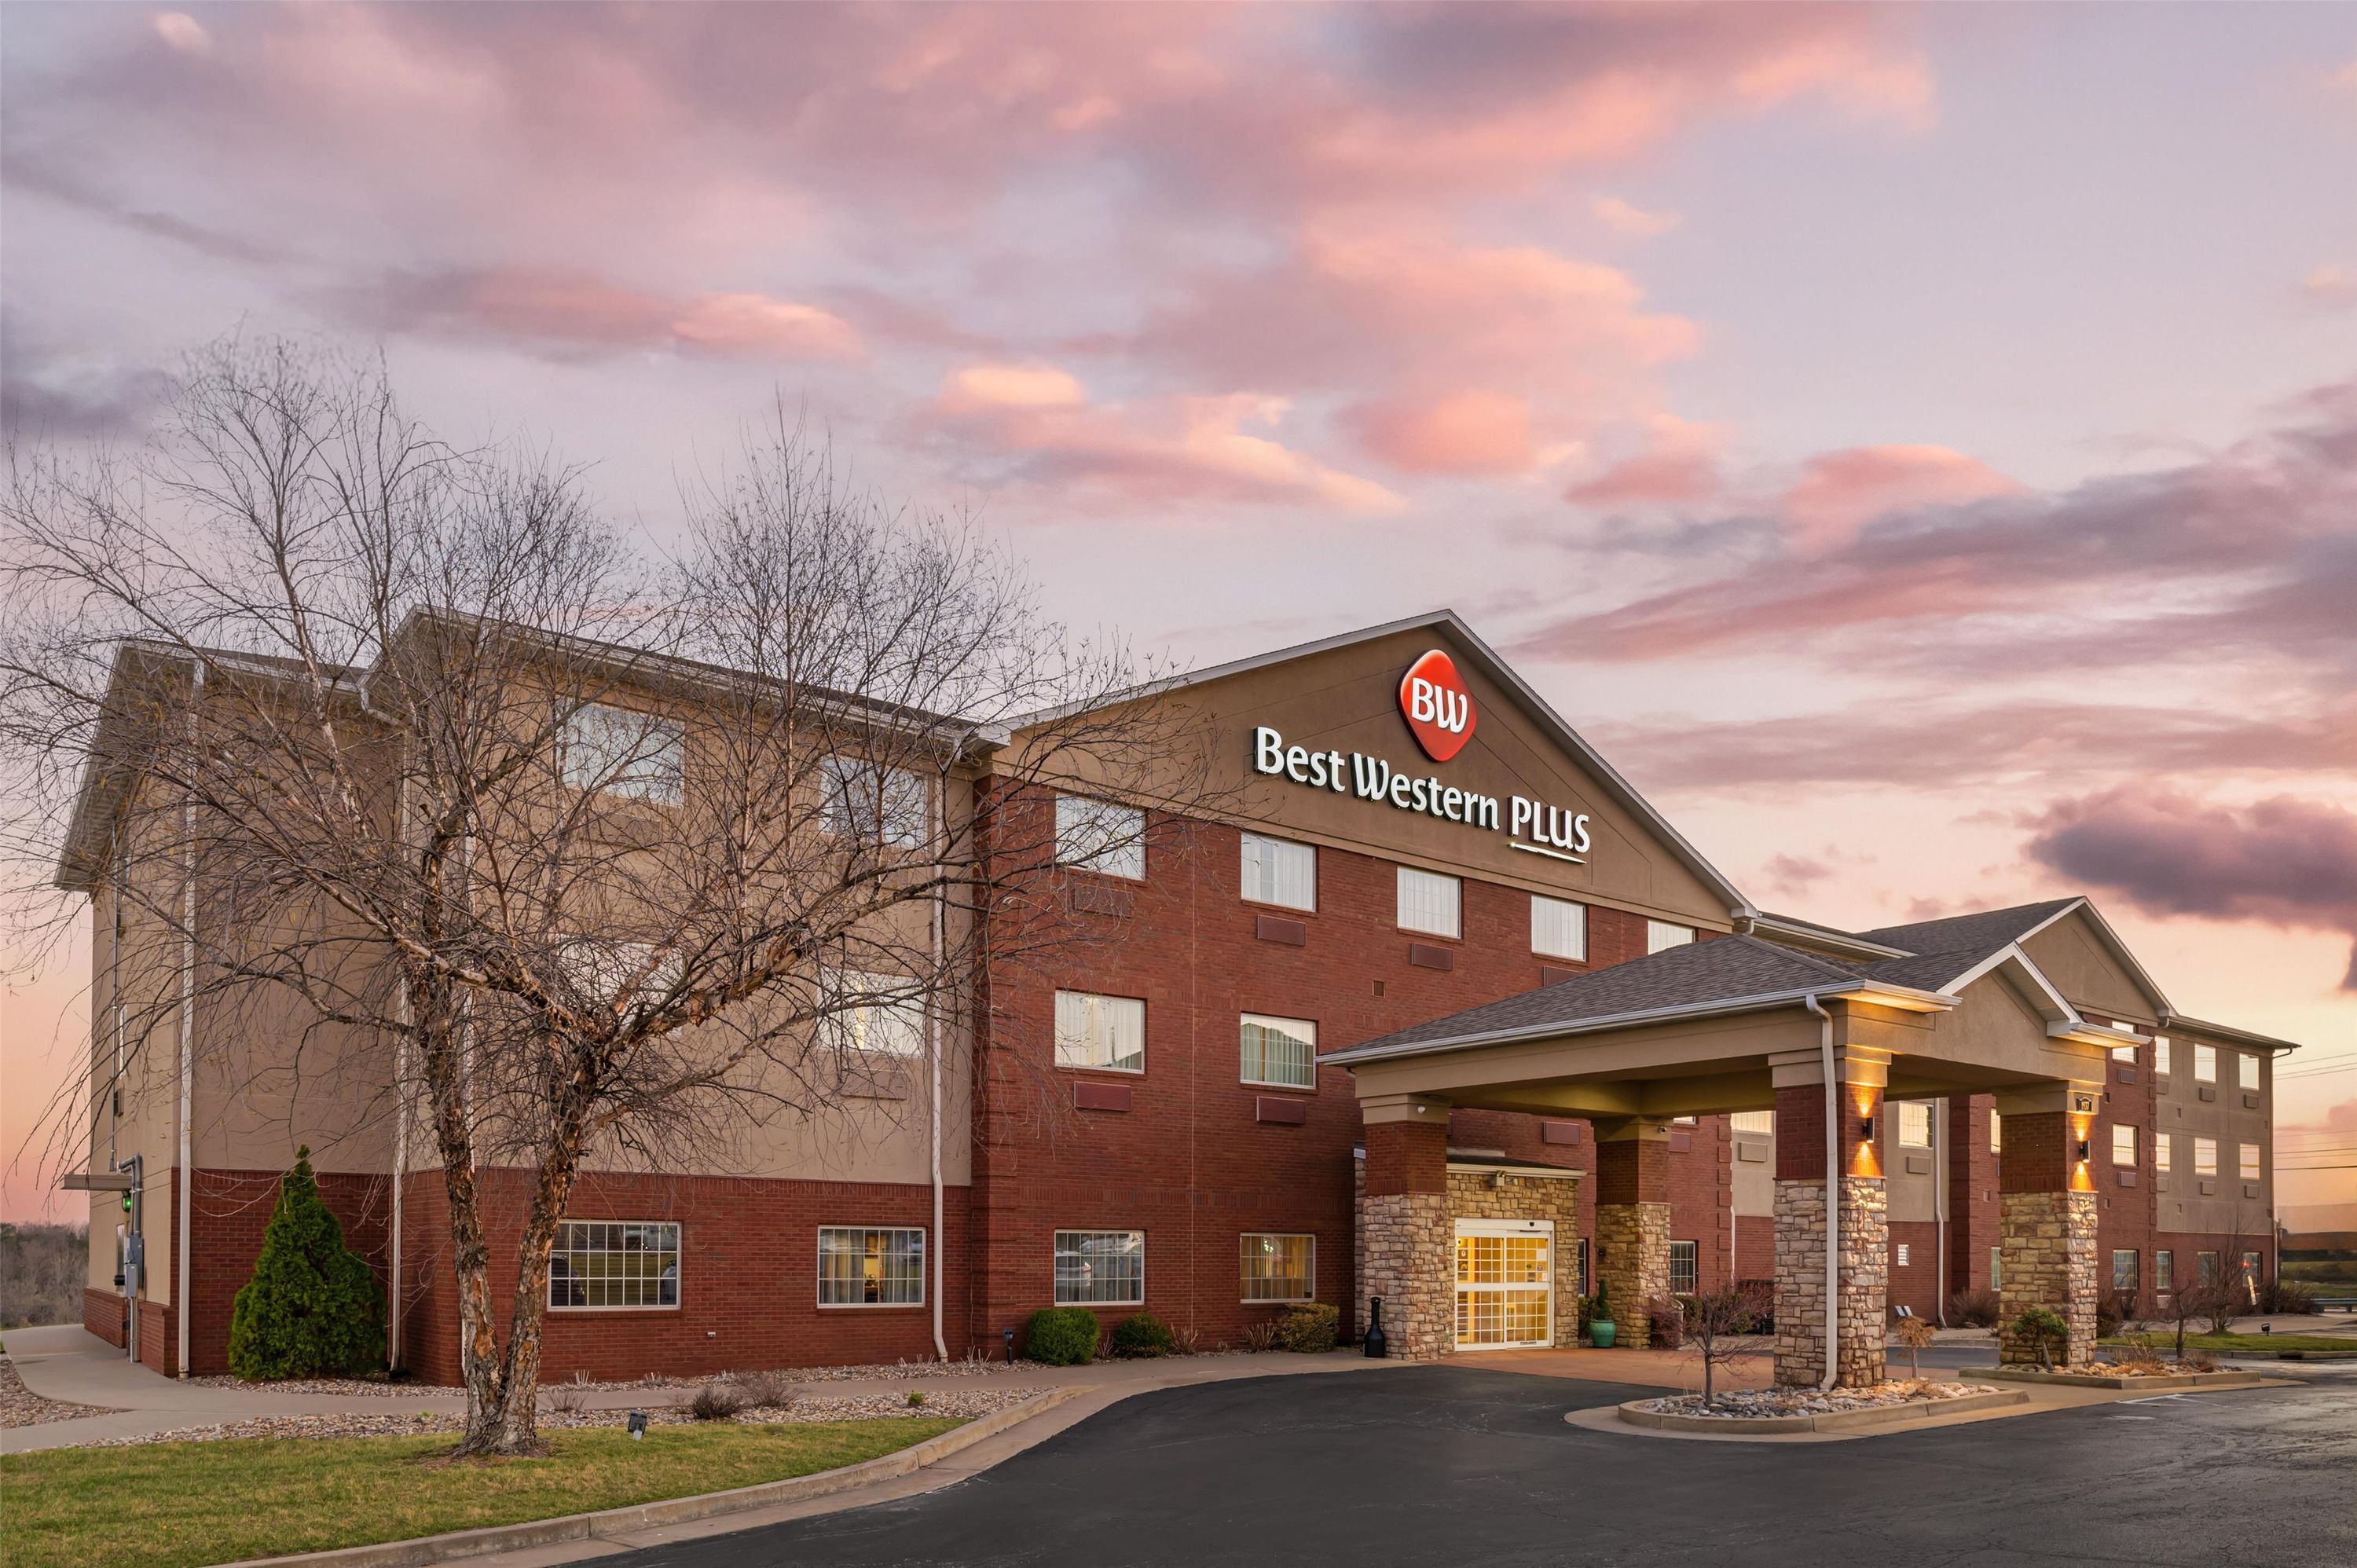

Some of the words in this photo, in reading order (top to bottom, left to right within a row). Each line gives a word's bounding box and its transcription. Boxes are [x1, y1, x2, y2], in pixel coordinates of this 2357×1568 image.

[1412, 677, 1468, 733] BW
[1255, 726, 1346, 793] Best
[1351, 752, 1500, 830] Western
[1510, 795, 1590, 853] PLUS
